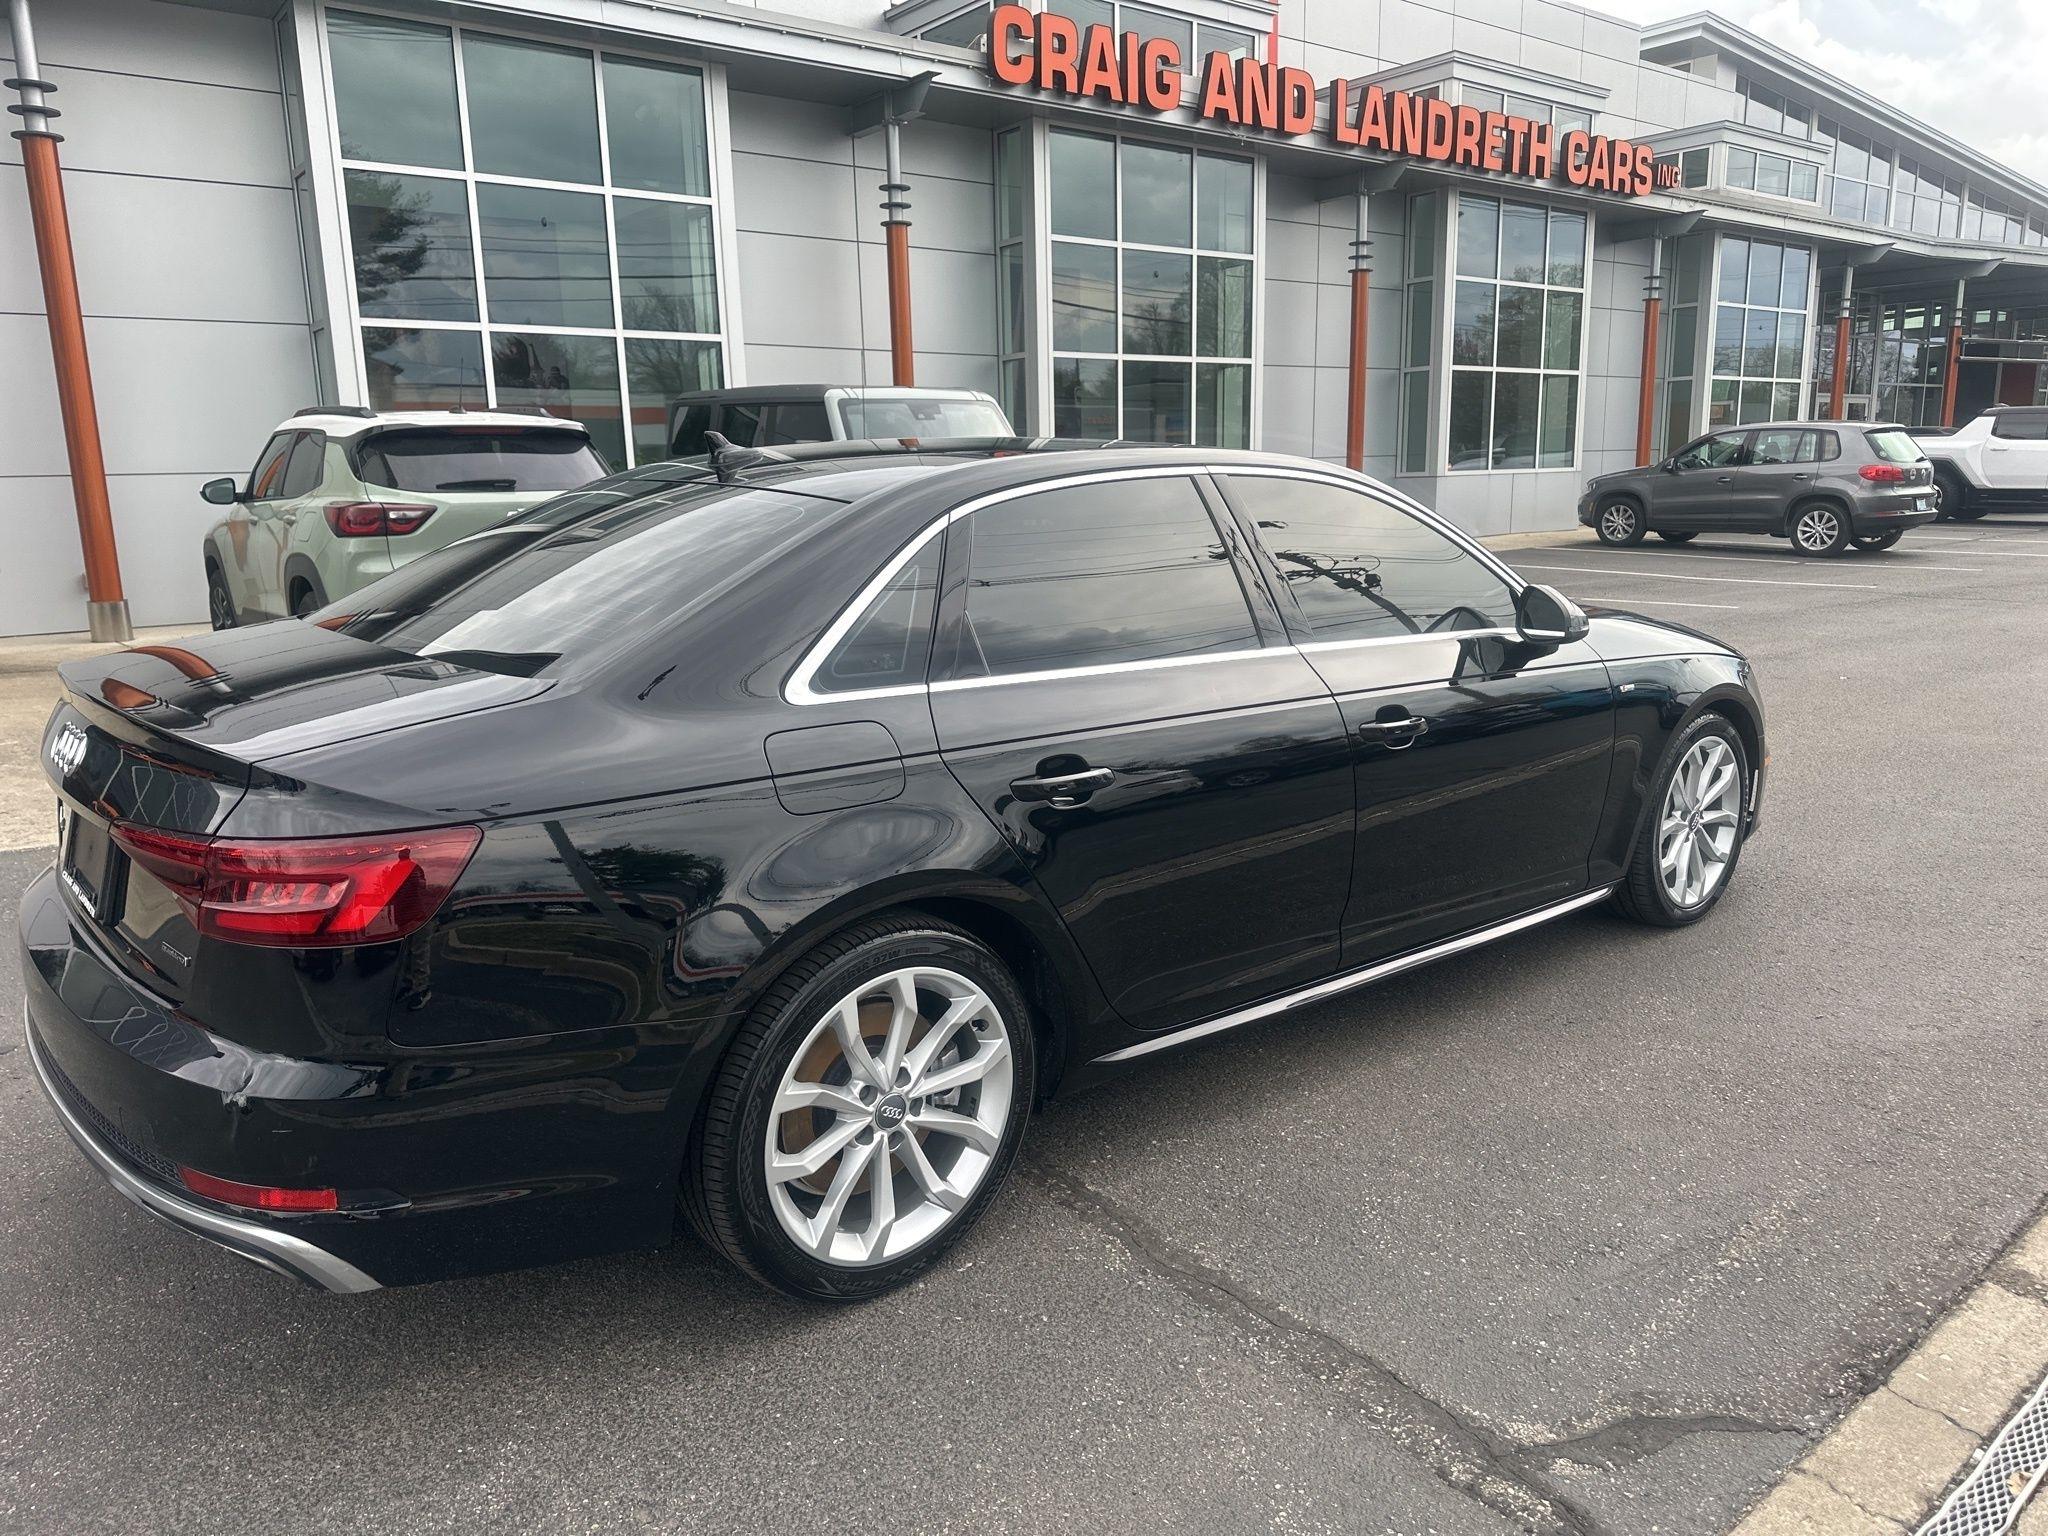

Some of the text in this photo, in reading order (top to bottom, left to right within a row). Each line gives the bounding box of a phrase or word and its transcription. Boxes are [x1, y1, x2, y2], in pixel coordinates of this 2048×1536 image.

[987, 4, 1182, 111] CRAIG
[1200, 51, 1315, 135] AND
[1330, 78, 1553, 179] LANDRETH
[1561, 130, 1654, 196] CARS
